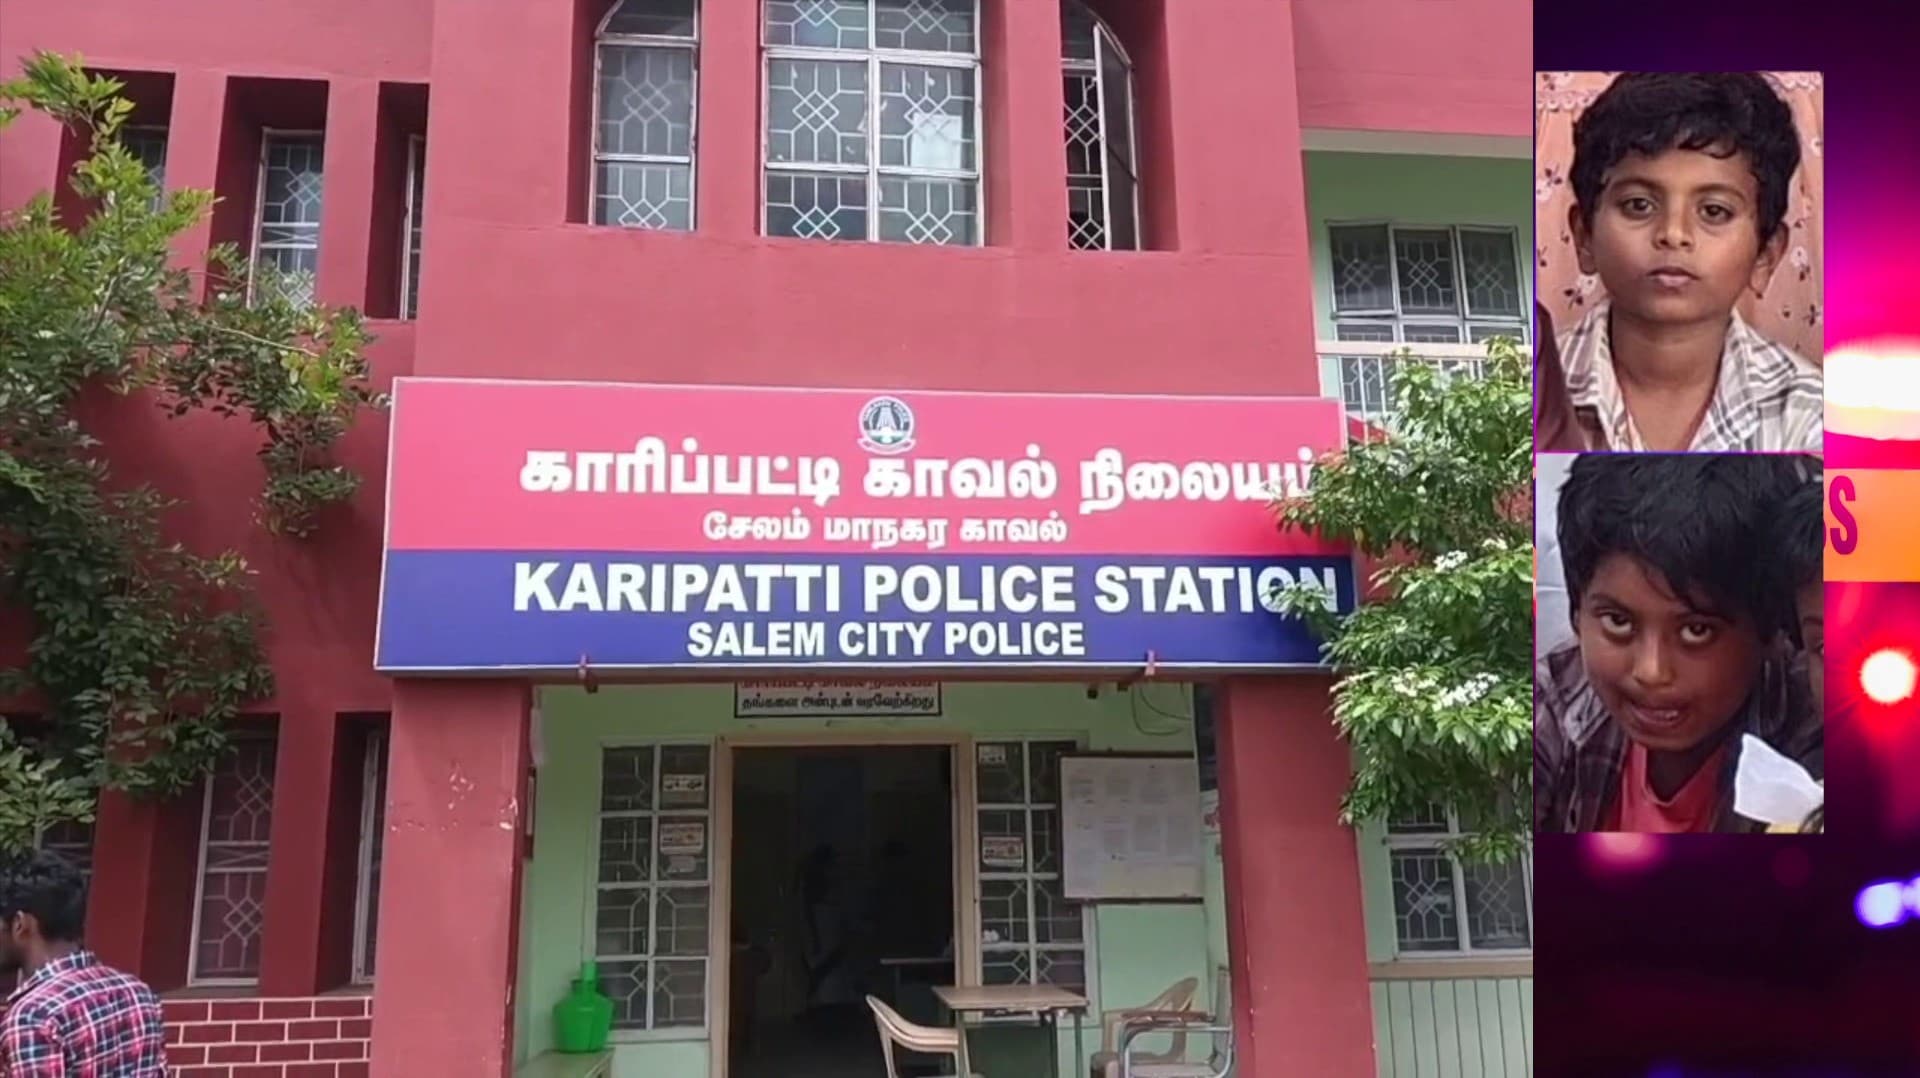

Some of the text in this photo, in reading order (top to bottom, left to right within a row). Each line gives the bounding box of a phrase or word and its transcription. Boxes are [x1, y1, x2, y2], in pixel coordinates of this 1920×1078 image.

[520, 436, 840, 507] காரிப்பட்டி
[864, 444, 1058, 501] காவல்
[703, 508, 1067, 550] சேலம் மாநகர காவல்
[514, 562, 1338, 614] KARIPATTI POLICE STATION
[687, 620, 1086, 658] SALEM CITY POLICE
